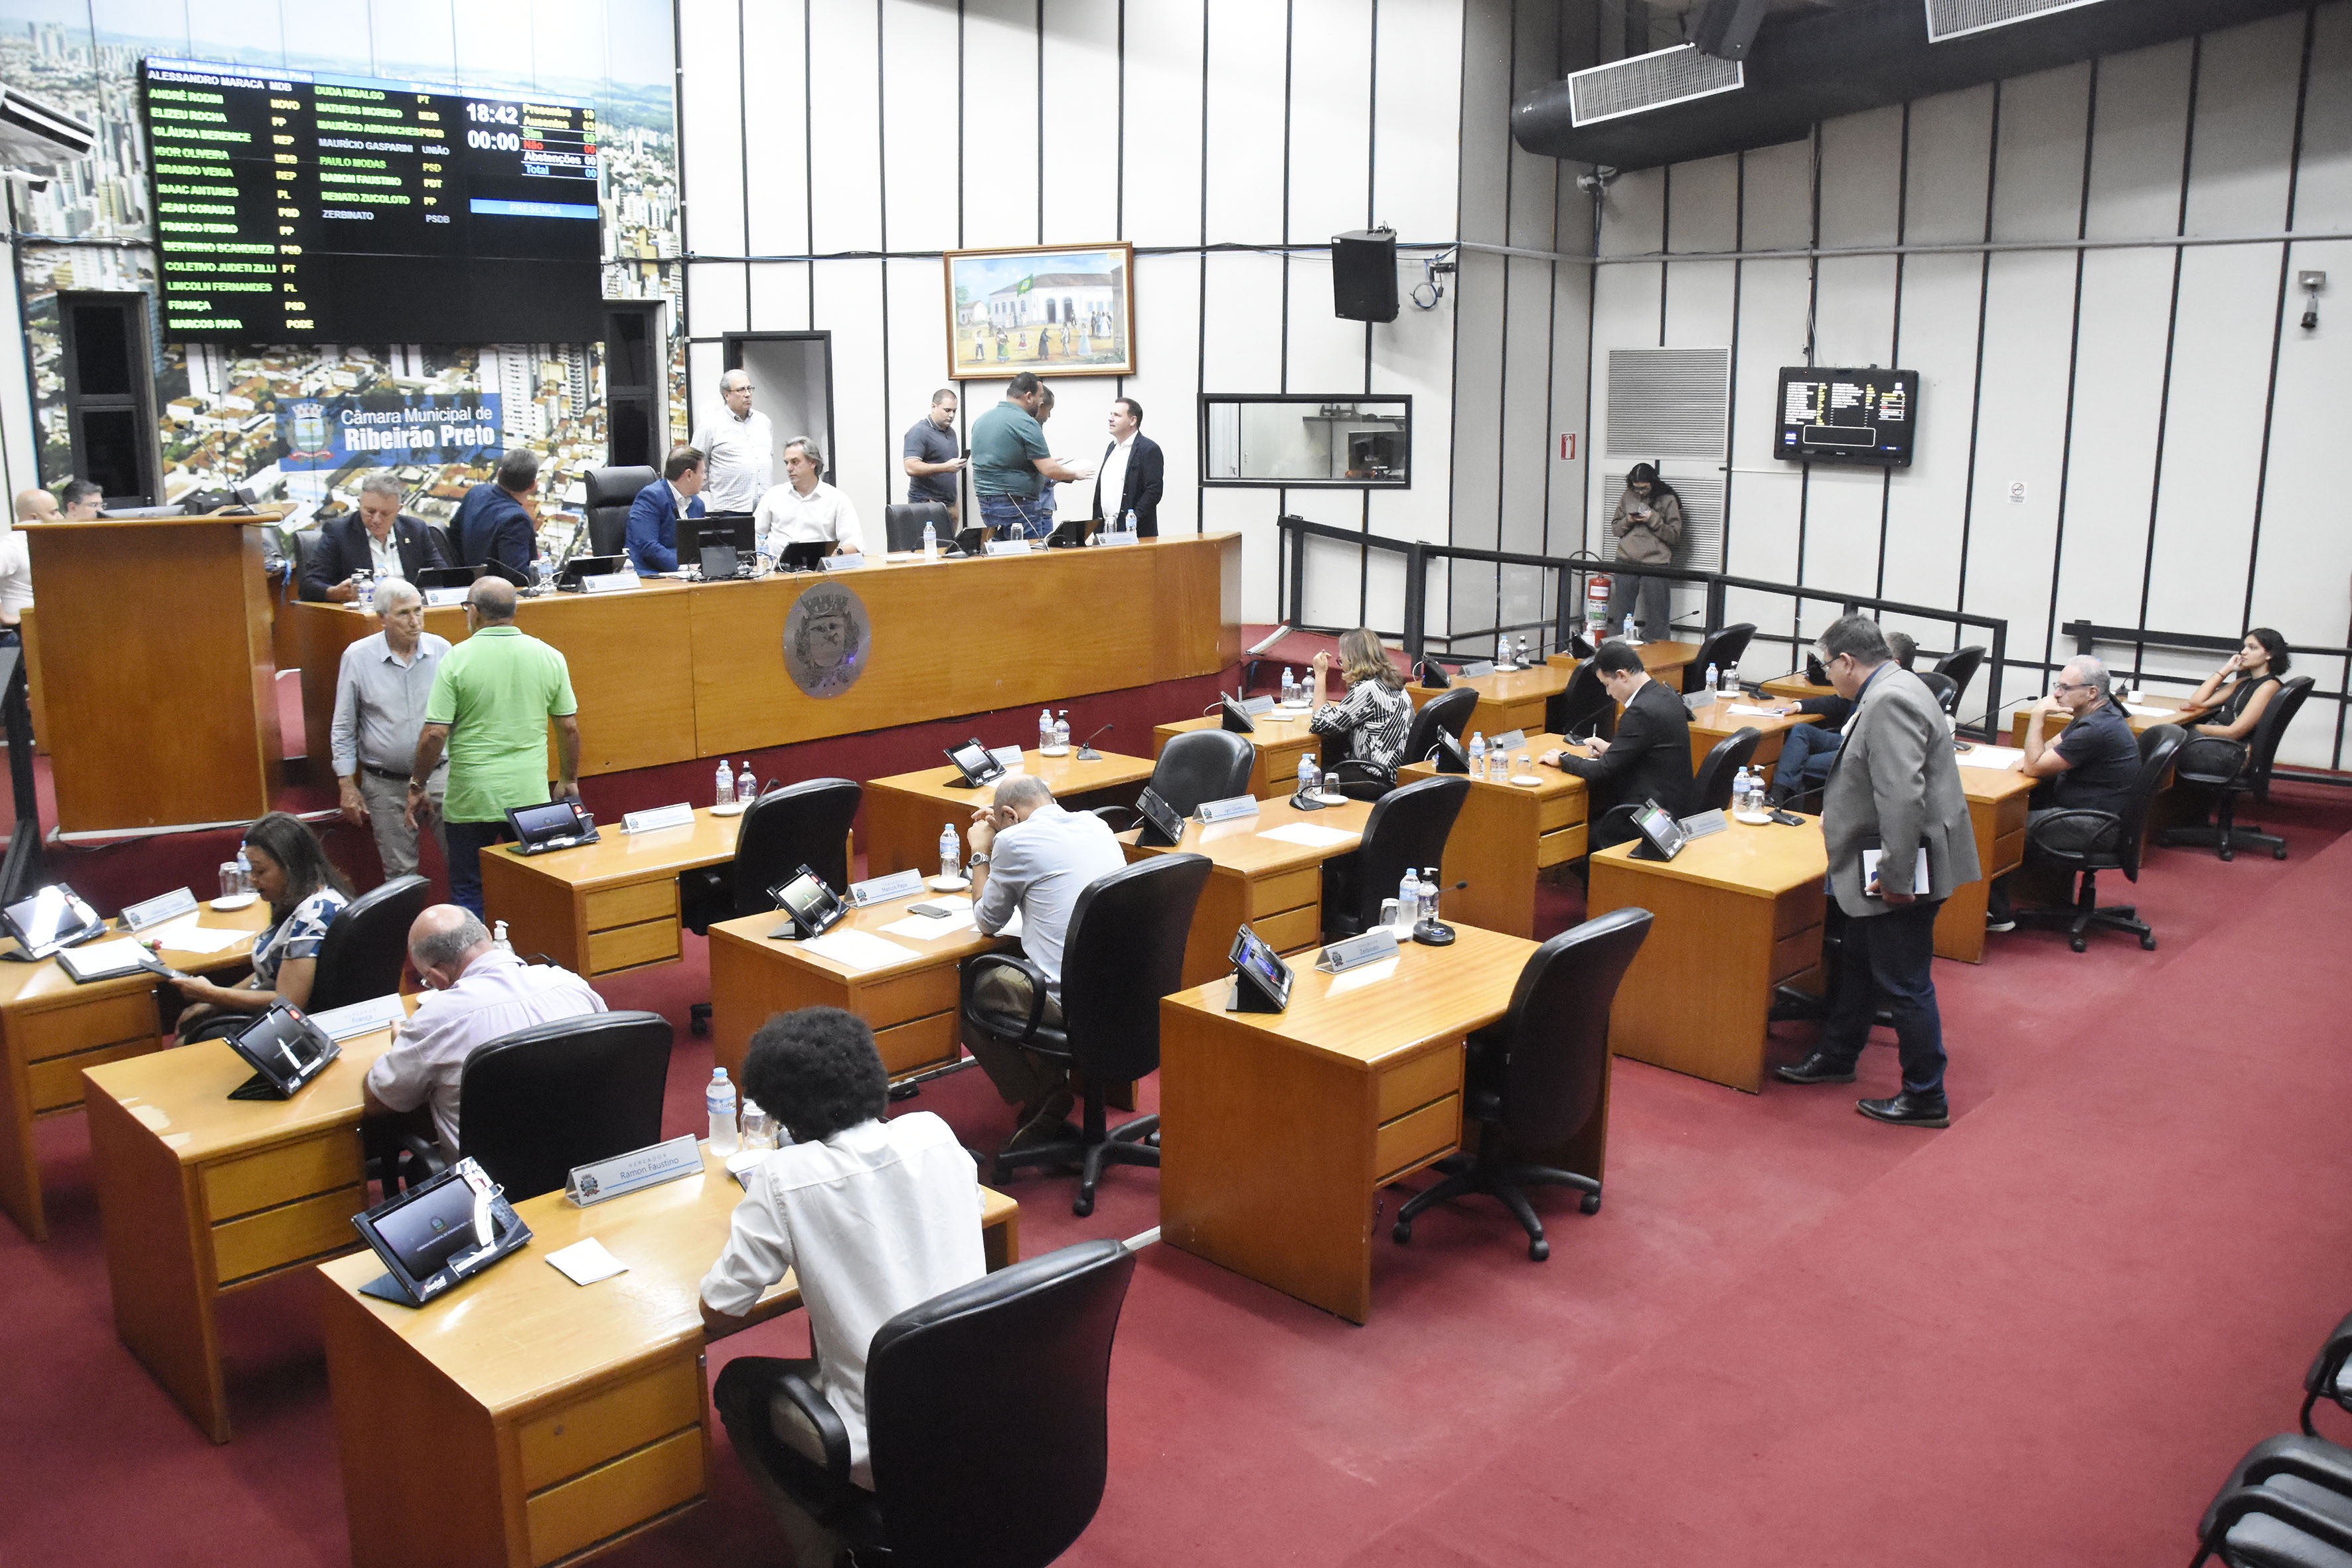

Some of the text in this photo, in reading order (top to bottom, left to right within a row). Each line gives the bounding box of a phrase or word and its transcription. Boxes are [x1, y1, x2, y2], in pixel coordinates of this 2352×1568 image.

[147, 58, 313, 82] Câmara Municipal de Ribeirão Preto
[148, 69, 293, 92] ALESSANDRO MARACA MDB
[149, 88, 300, 110] ANDRÉ RODINI NOVO
[314, 85, 430, 104] DUDA HIDALGO PT
[150, 107, 287, 126] ELIZEU ROCHA PP
[315, 102, 439, 121] MATHEUS MORENO MDB
[467, 103, 518, 125] 18:42
[522, 103, 595, 119] Presentes 19
[317, 120, 444, 138] MAURÍCIO ABRANCHES PSDB
[523, 116, 595, 131] Ausentes 03
[152, 125, 294, 145] GLÁUCIA BERENICE REP
[467, 129, 520, 151] 00:00
[522, 128, 595, 143] Sim 00
[319, 138, 449, 155] MAURÍCIO GASPARINI UNIÃO
[523, 139, 596, 154] Não 00
[153, 146, 297, 164] IGOR OLIVEIRA MDB
[523, 151, 597, 165] Abstenções 00
[155, 164, 297, 180] BRANDO VEIGA REP
[319, 157, 441, 172] PAULO MODAS PSD
[524, 163, 597, 178] Total 00
[320, 173, 443, 188] RAMON FAUSTINO PDT
[157, 184, 291, 199] ISAAC ANTUNES PL
[321, 192, 360, 202] RENATO
[360, 194, 410, 204] ZUCOLOTO
[159, 202, 187, 213] JEAN
[278, 208, 299, 217] PSD
[323, 210, 450, 223] ZERBINATO PSDB
[510, 204, 561, 214] PRESENÇA
[159, 221, 294, 235] FRANCO FERRO PP
[162, 241, 216, 252] BERTINHO
[280, 245, 302, 254] PSD
[165, 262, 217, 272] COLETIVO
[282, 264, 295, 273] PT
[167, 281, 297, 292] LINCOLN FERNANDES PL
[168, 301, 306, 311] FRANÇA PSD
[169, 319, 314, 329] MARCOS PAPA PODE
[341, 406, 493, 425] Câmara Municipal de
[345, 424, 495, 451] Ribeirão Preto
[620, 1157, 679, 1180] Ramon Faustino
